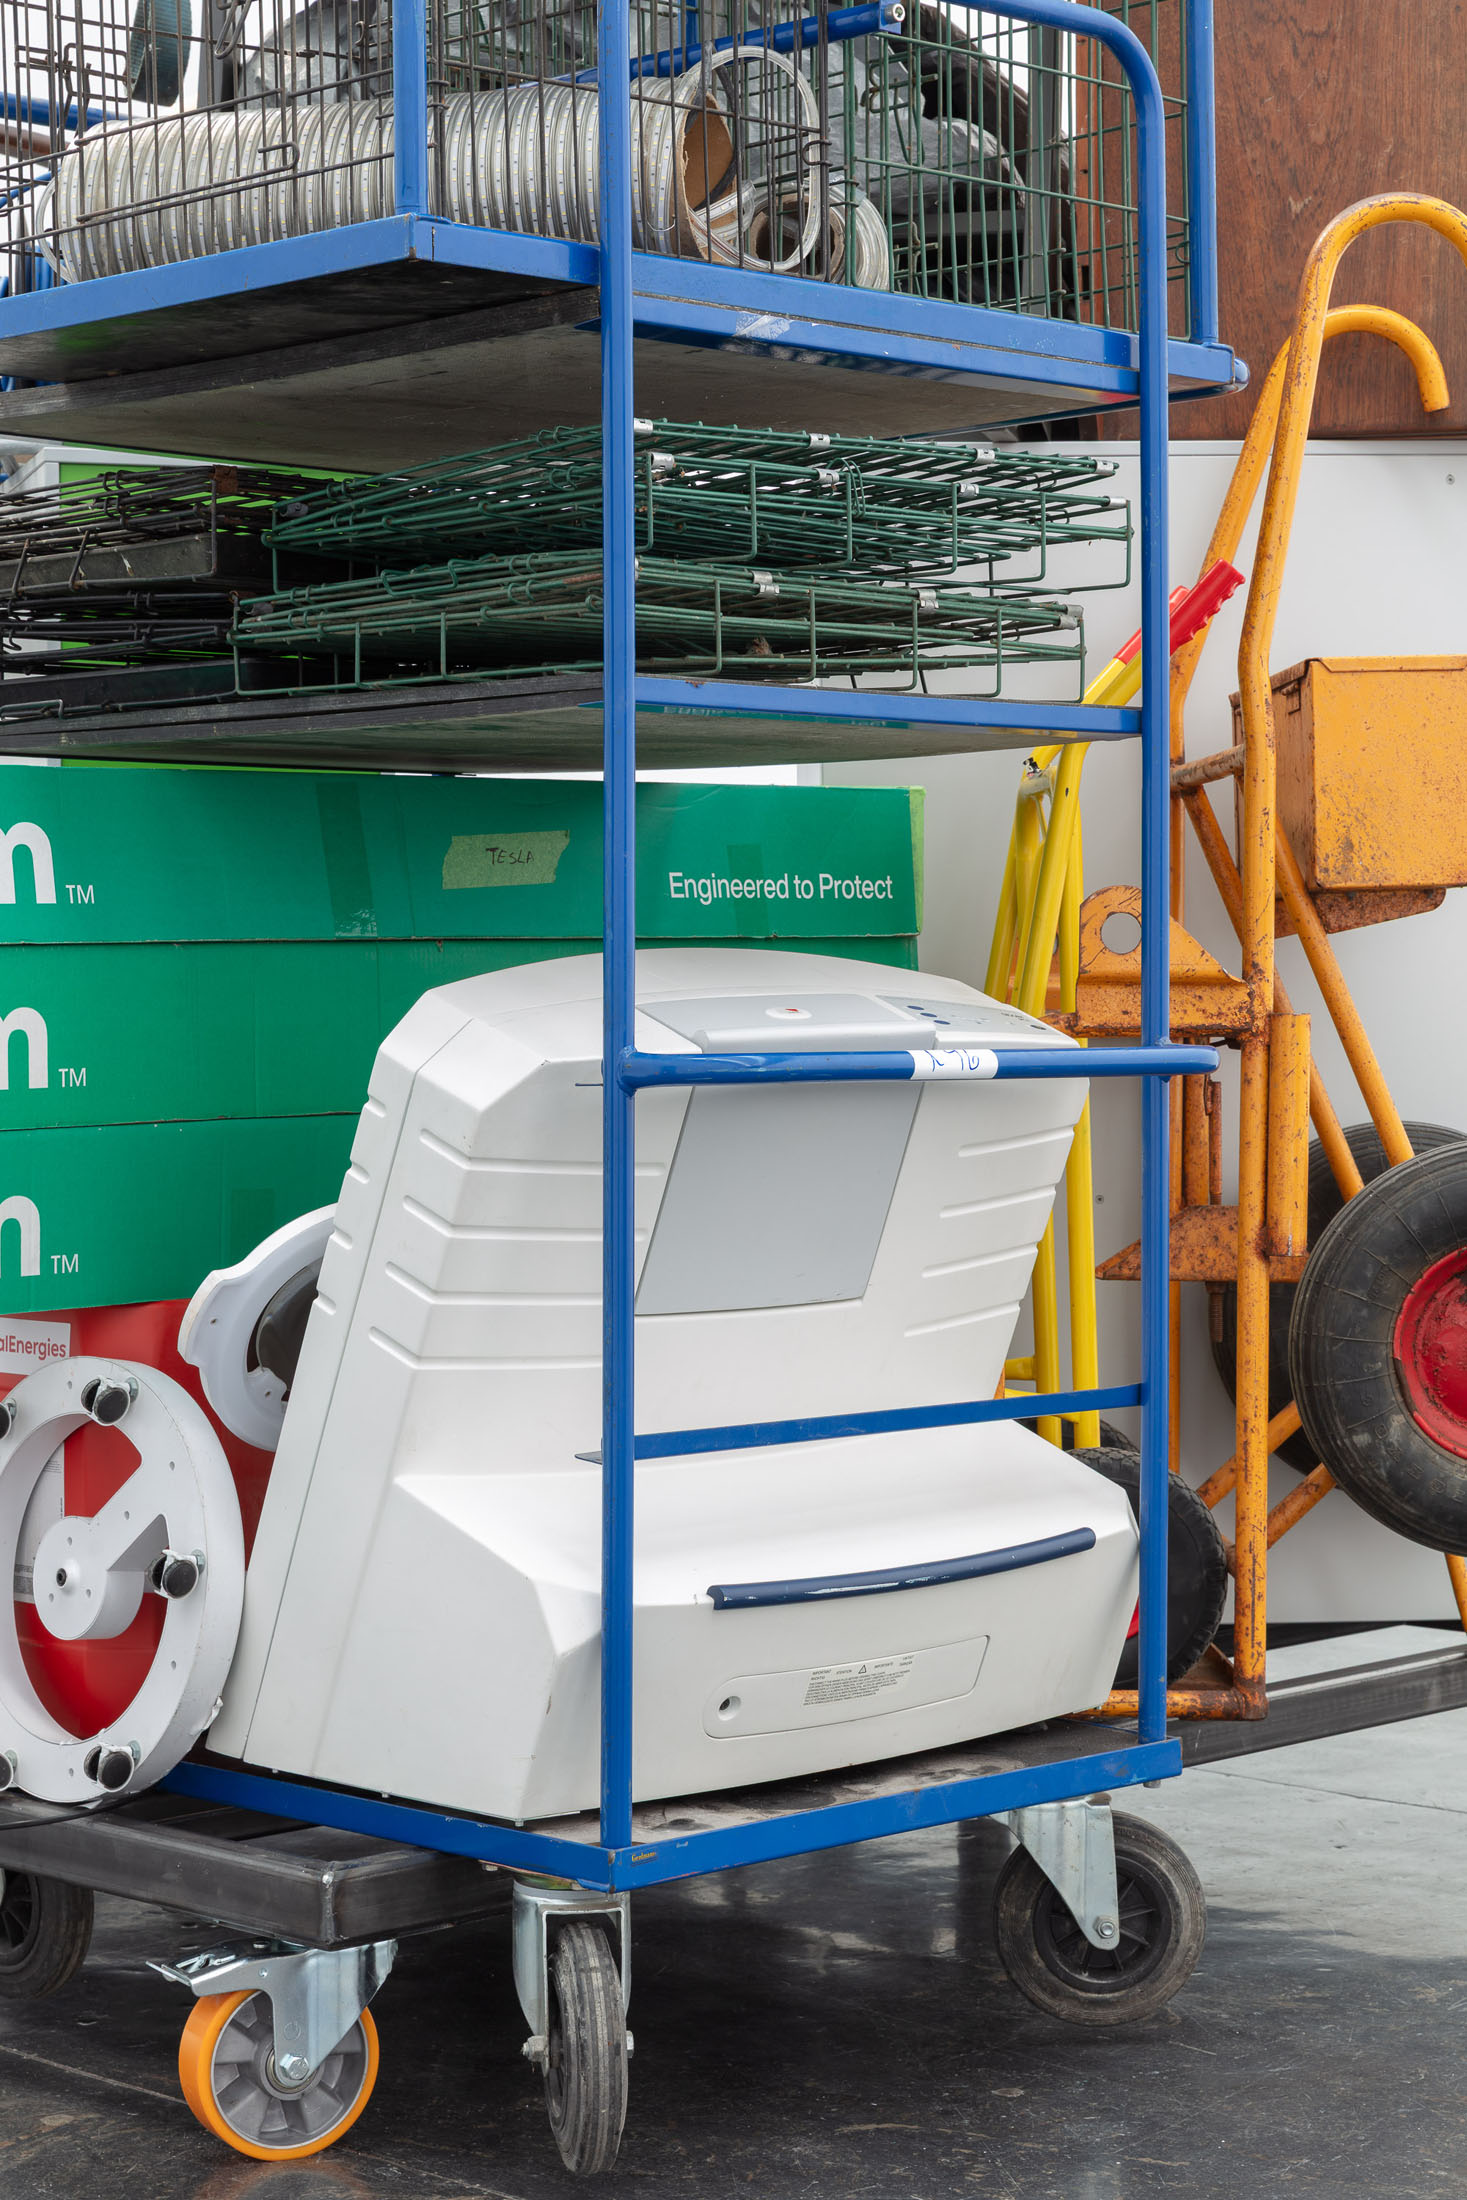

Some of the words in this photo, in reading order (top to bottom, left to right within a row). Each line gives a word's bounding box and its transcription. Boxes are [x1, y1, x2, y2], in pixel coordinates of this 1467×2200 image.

[486, 847, 535, 865] TESLA
[668, 871, 790, 906] Engineered
[793, 873, 815, 899] to
[818, 872, 894, 899] Protect
